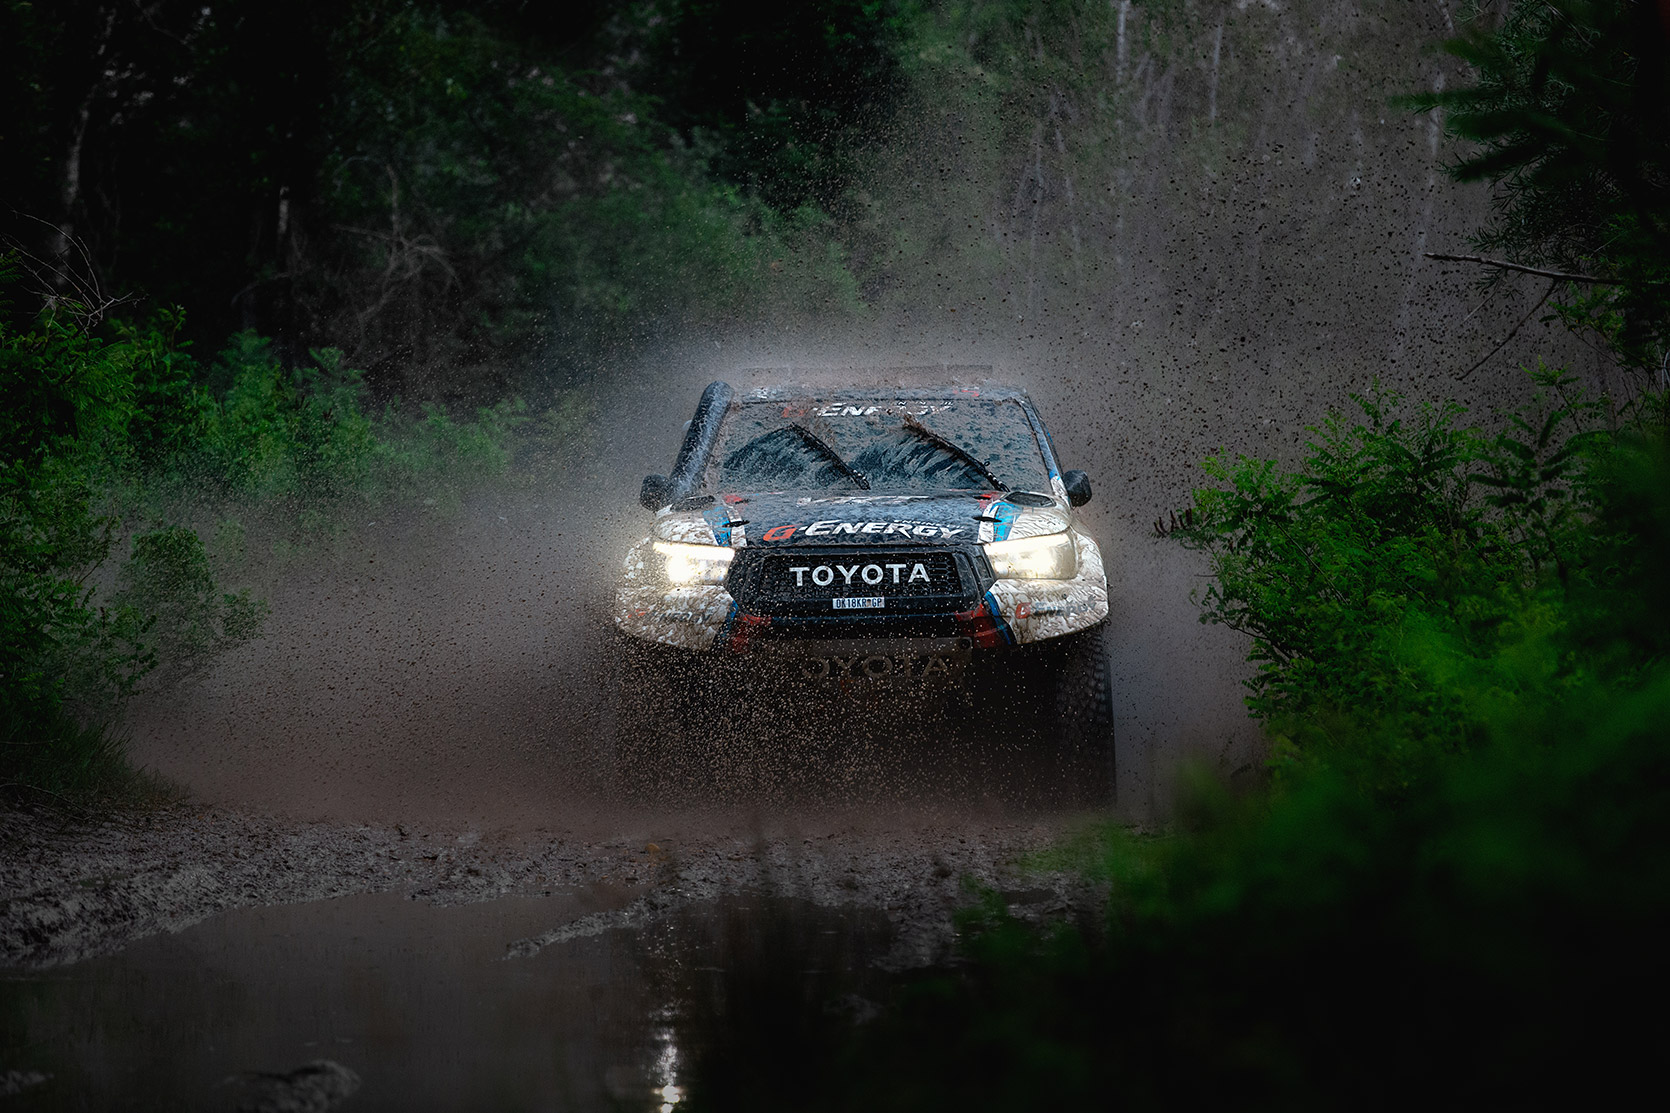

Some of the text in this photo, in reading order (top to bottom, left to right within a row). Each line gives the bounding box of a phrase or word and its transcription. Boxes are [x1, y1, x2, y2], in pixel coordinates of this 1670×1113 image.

[763, 520, 963, 541] G-ENERGY
[789, 563, 930, 587] TOYOTA
[801, 655, 948, 679] OYOTA
